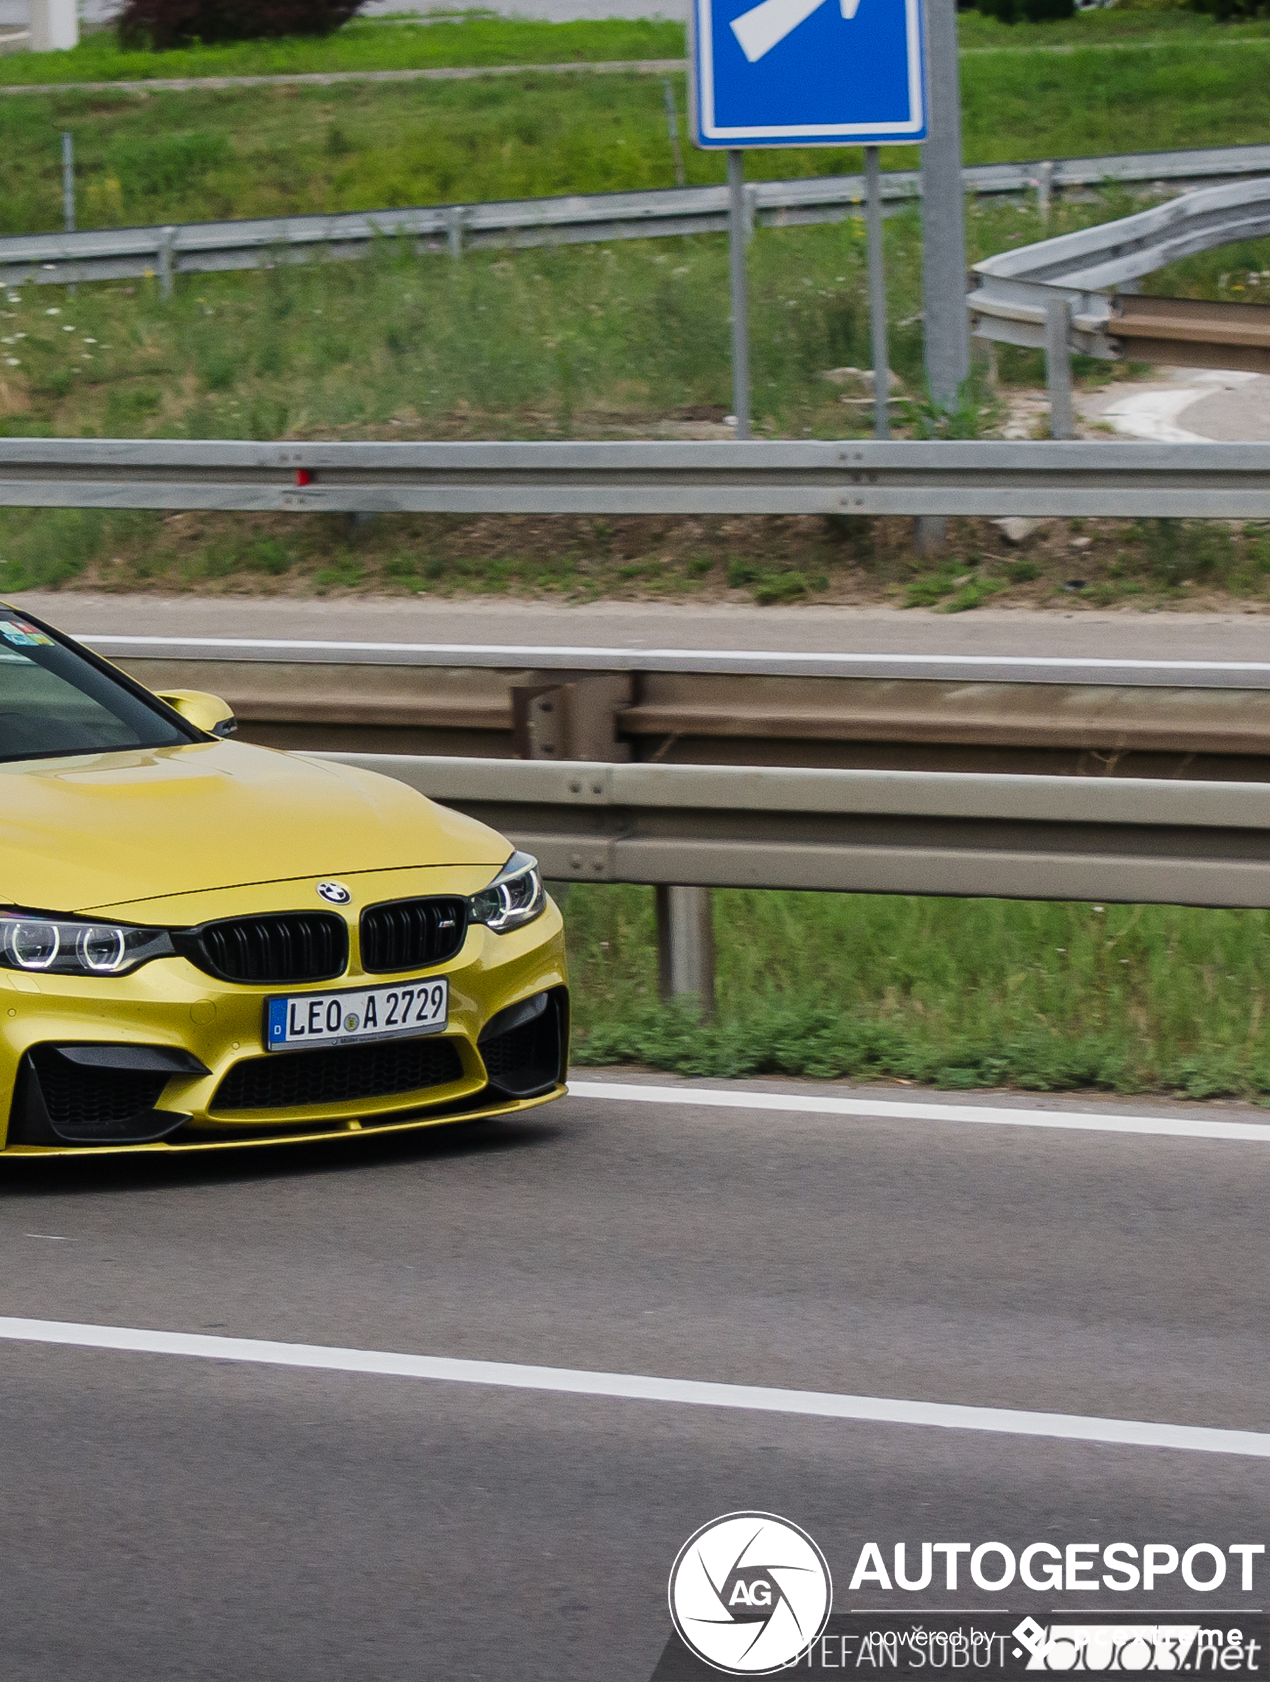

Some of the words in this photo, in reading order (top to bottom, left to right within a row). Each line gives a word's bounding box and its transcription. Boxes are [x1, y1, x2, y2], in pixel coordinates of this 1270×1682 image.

[289, 999, 341, 1036] LEO
[363, 995, 377, 1029] A
[385, 985, 443, 1026] 2729
[273, 1025, 281, 1035] D
